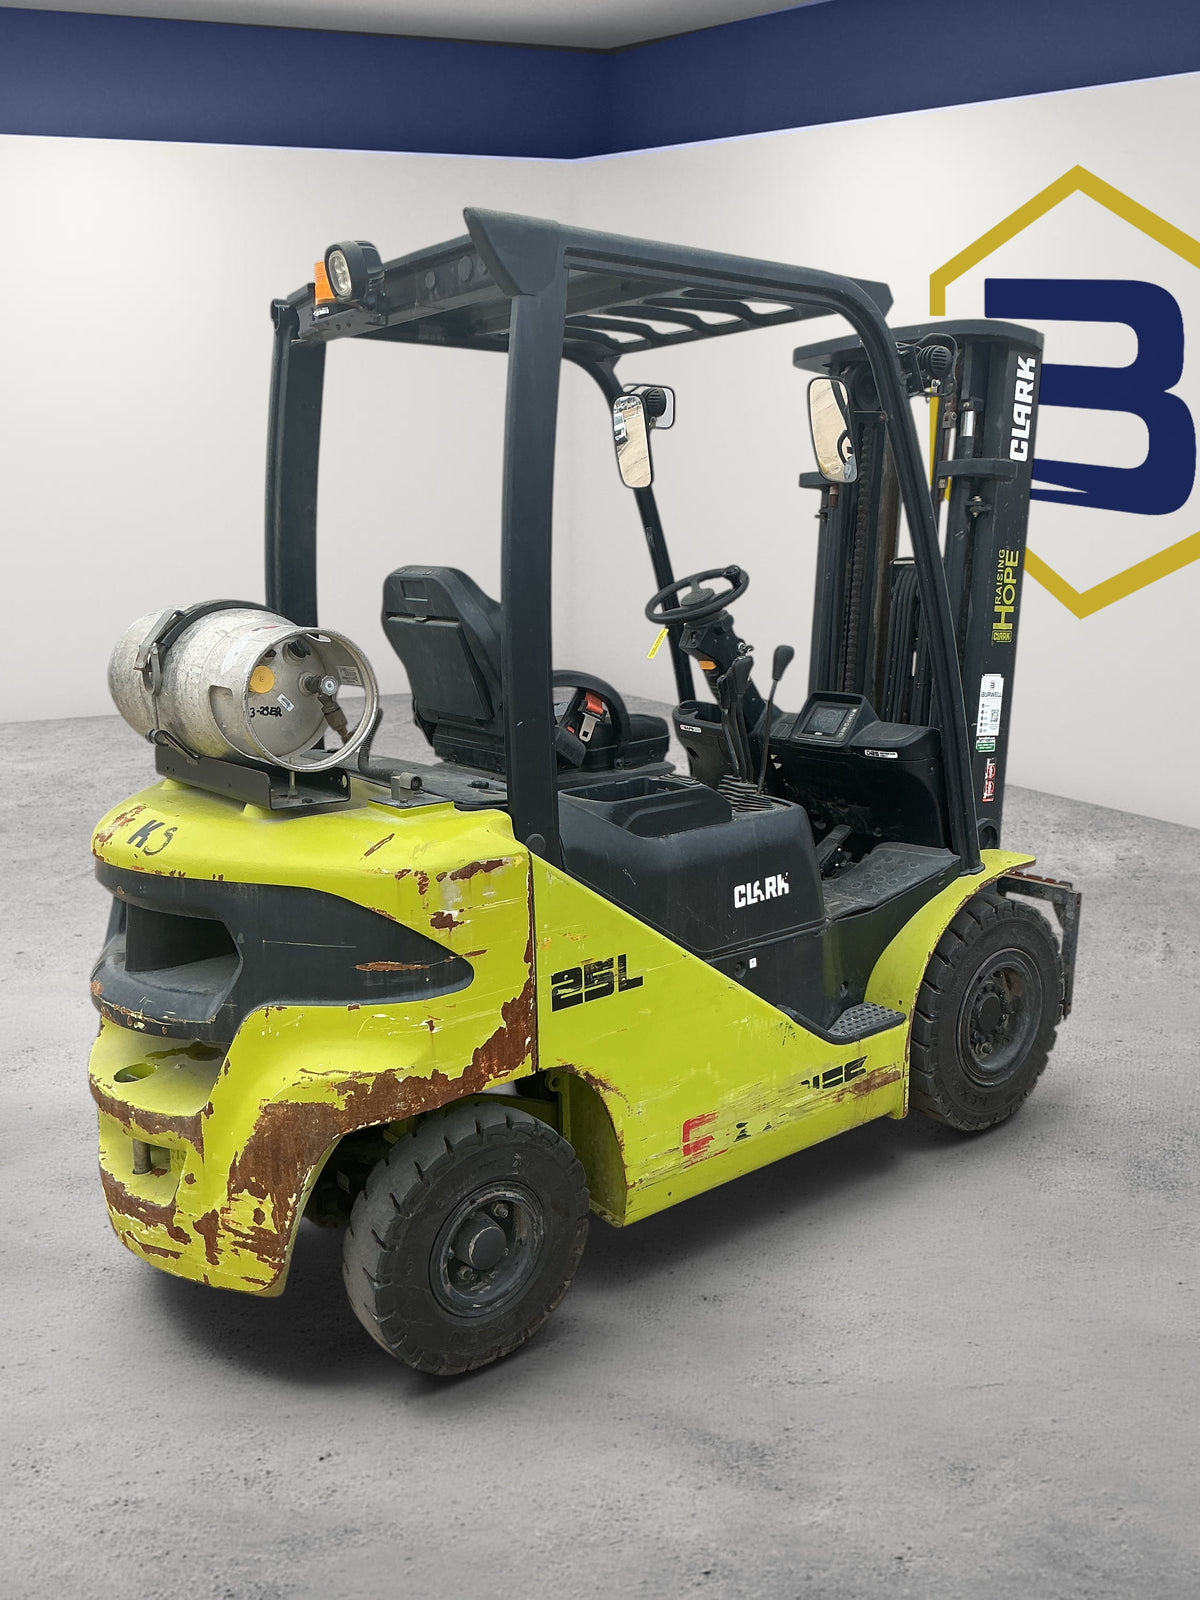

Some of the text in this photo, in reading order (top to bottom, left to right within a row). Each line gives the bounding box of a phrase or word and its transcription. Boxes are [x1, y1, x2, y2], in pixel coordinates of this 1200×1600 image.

[1009, 355, 1036, 462] CLARK
[992, 550, 1019, 630] HOPE
[994, 549, 1006, 605] RAISING
[734, 871, 790, 909] CLARK
[551, 953, 644, 1012] 25L
